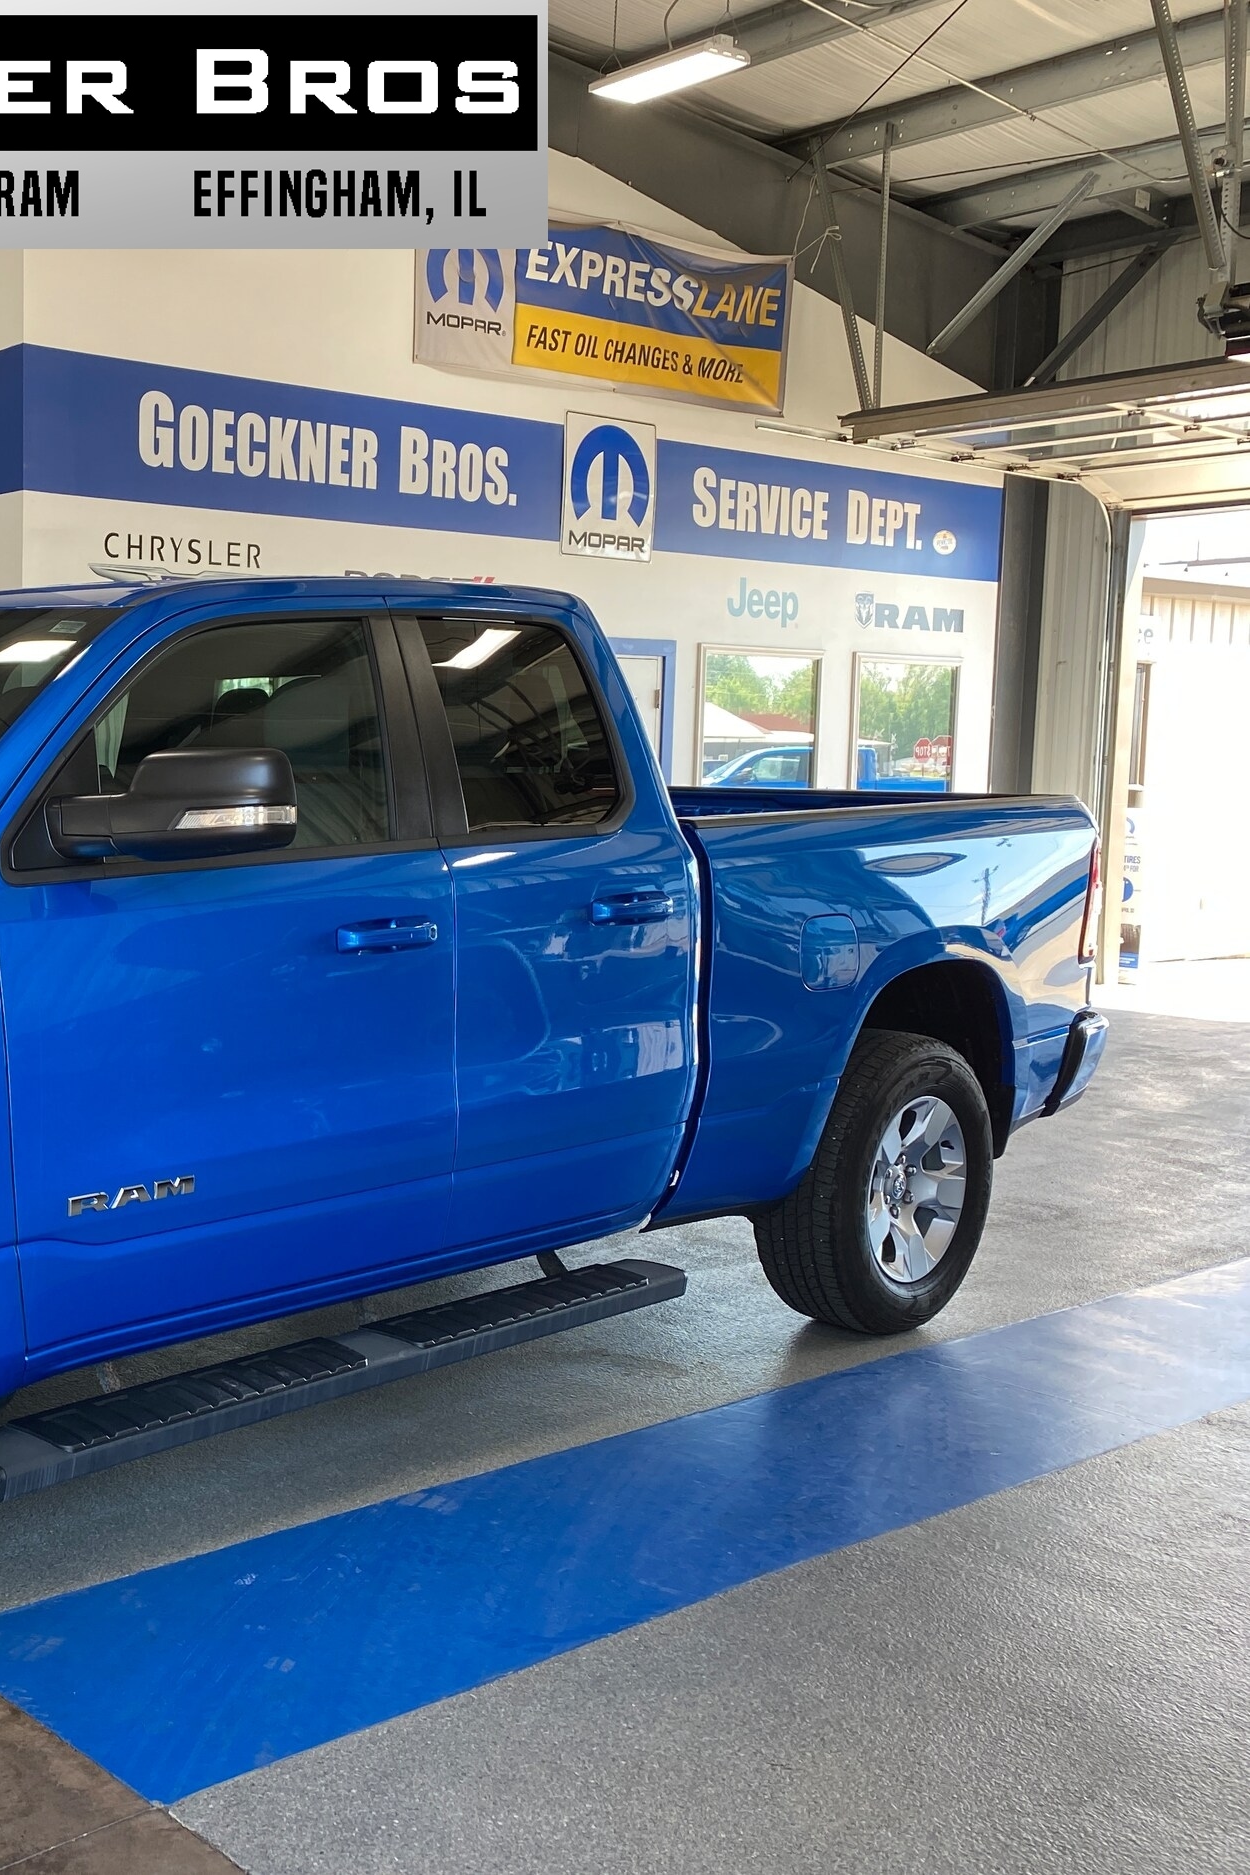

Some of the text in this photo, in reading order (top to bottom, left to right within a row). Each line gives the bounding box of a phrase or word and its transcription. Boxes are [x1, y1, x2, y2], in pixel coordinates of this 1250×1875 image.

[426, 310, 502, 337] MOPAR
[526, 323, 745, 384] FAST OIL CHANGES & MORE
[138, 390, 518, 506] GOECKNER BROS.
[692, 466, 923, 551] SERVICE DEPT.
[103, 531, 262, 569] CHRYSLER
[568, 529, 646, 554] MOPAR
[726, 576, 799, 629] Jeep
[874, 602, 965, 634] RAM
[67, 1174, 196, 1218] RAM
